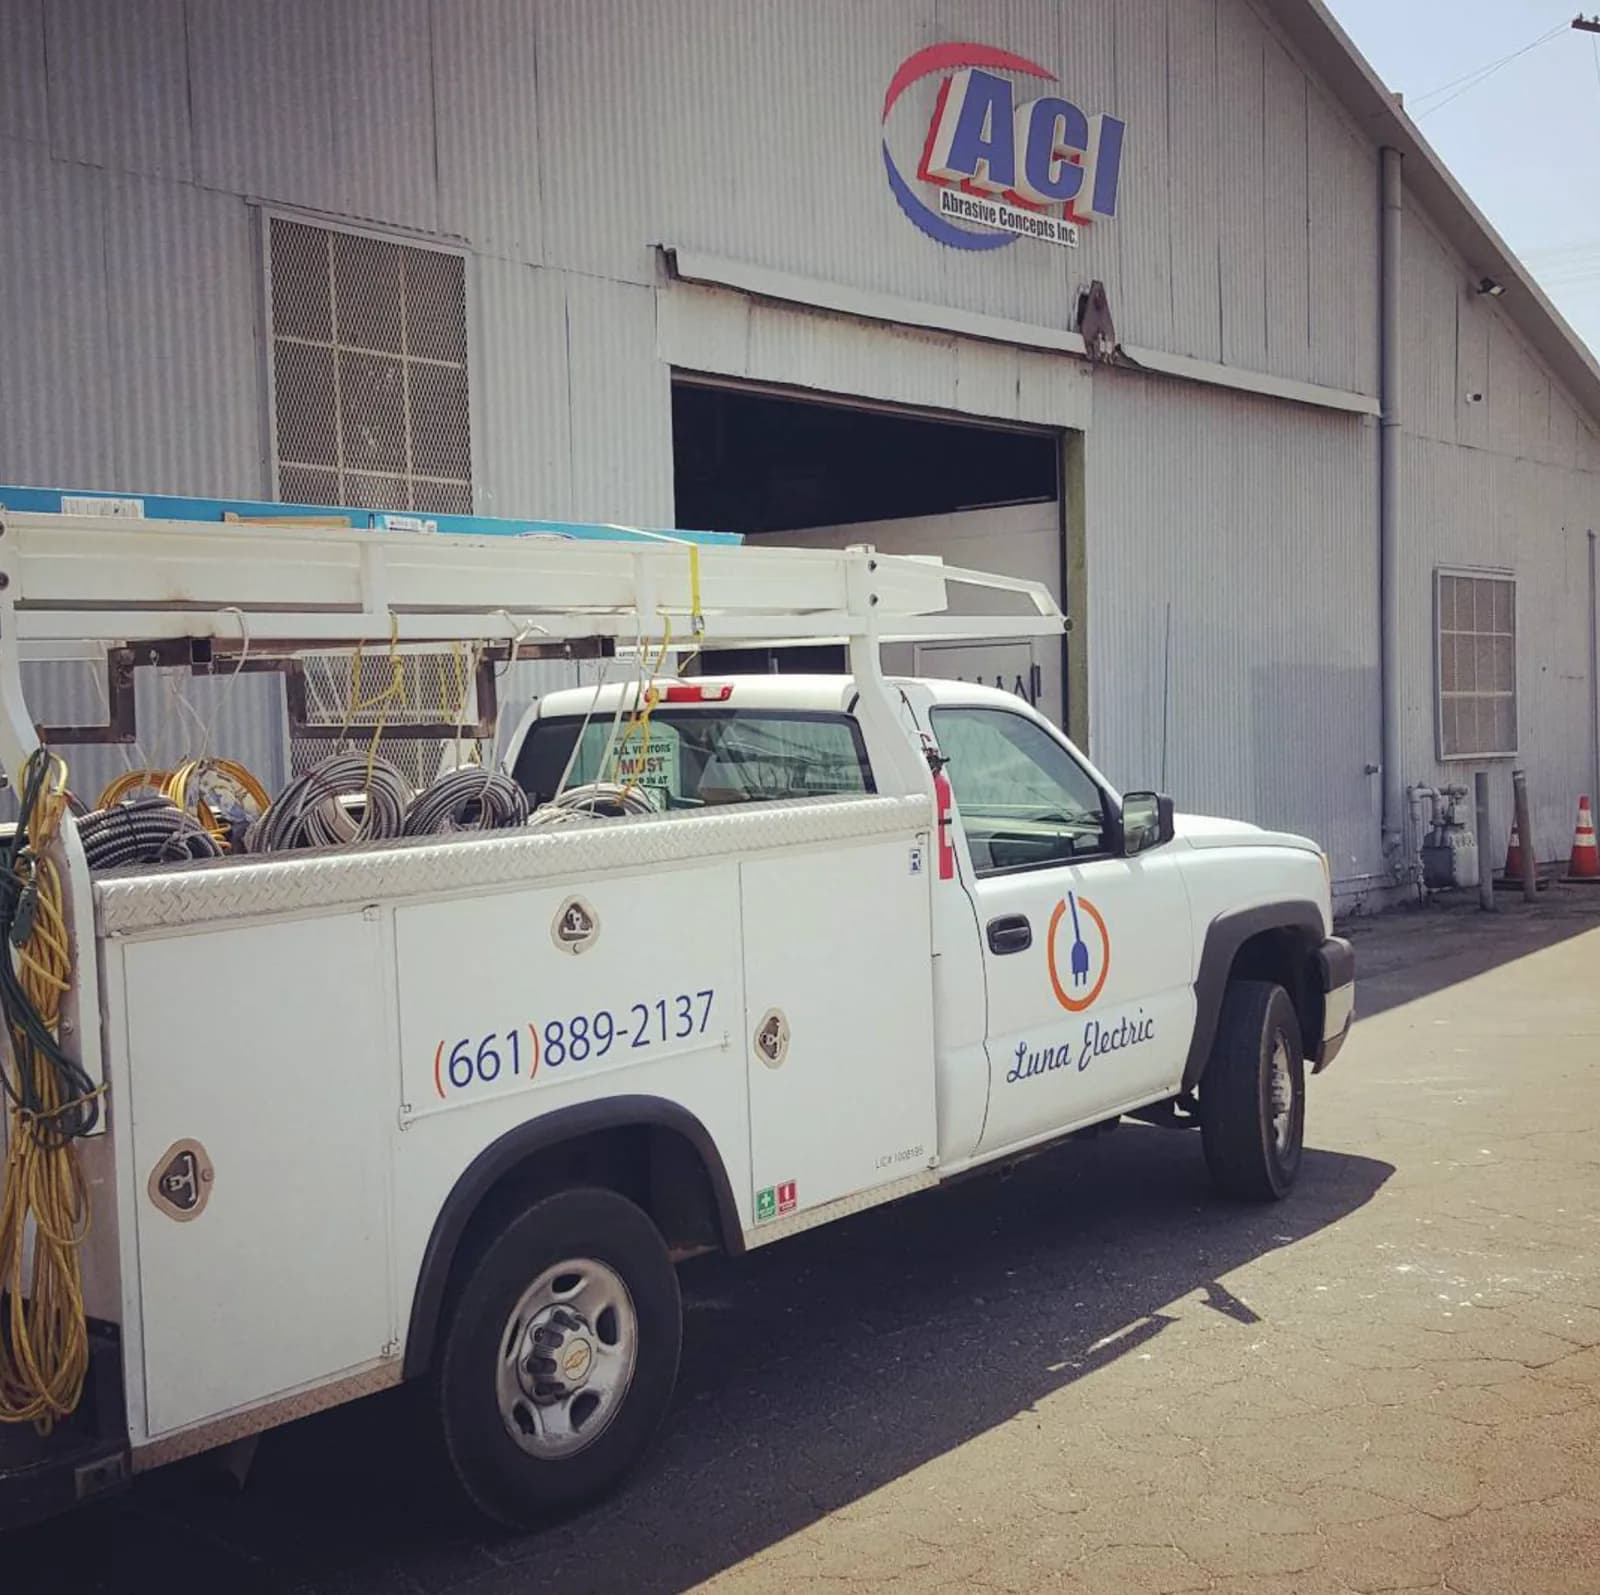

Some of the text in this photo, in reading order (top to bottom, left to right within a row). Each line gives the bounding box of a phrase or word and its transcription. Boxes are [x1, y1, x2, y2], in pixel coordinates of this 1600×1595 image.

[926, 67, 1127, 218] ACI
[941, 190, 996, 224] Abrasive
[998, 206, 1056, 239] Concepts
[620, 756, 665, 775] MUST
[632, 743, 671, 755] VIITORS
[1006, 1007, 1154, 1083] Luna Electric
